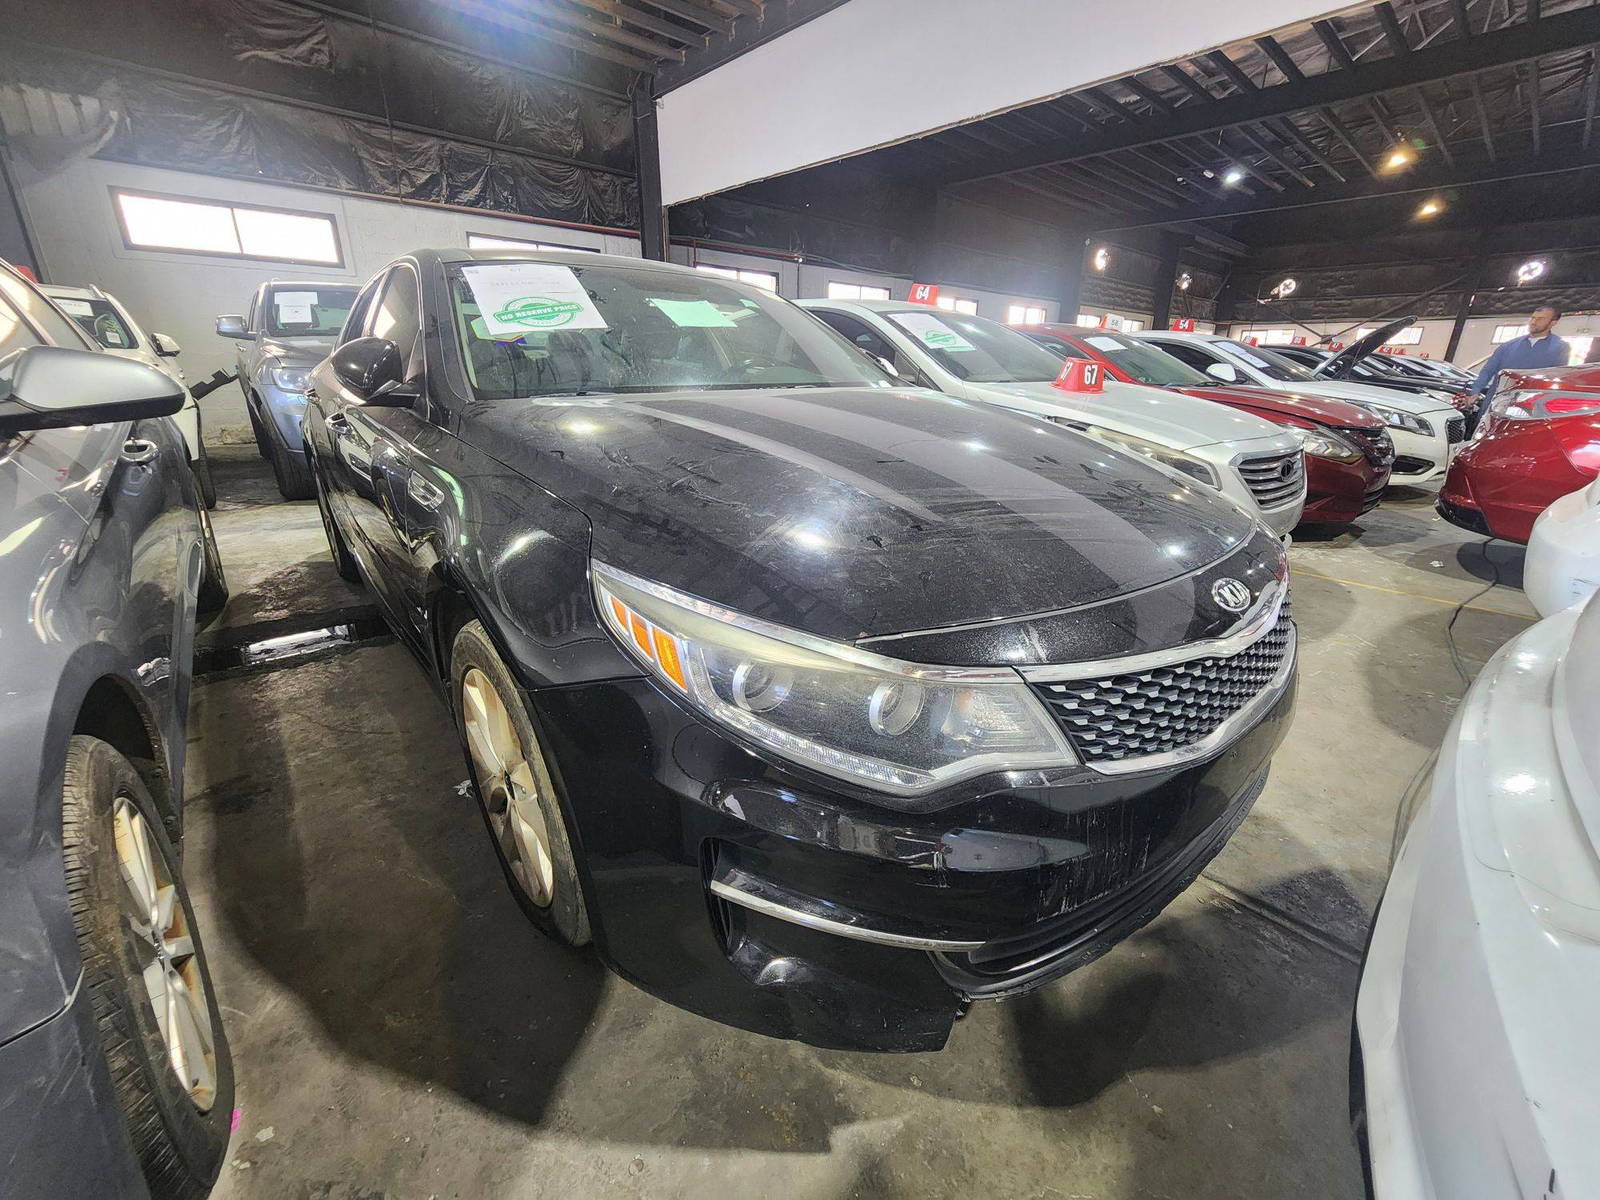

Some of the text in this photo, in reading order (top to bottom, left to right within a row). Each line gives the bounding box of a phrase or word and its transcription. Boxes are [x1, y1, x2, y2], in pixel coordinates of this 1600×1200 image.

[916, 286, 930, 300] 64
[500, 303, 578, 321] NO RESERVE PRICE
[1084, 364, 1099, 385] 67
[1217, 580, 1247, 608] KIA
